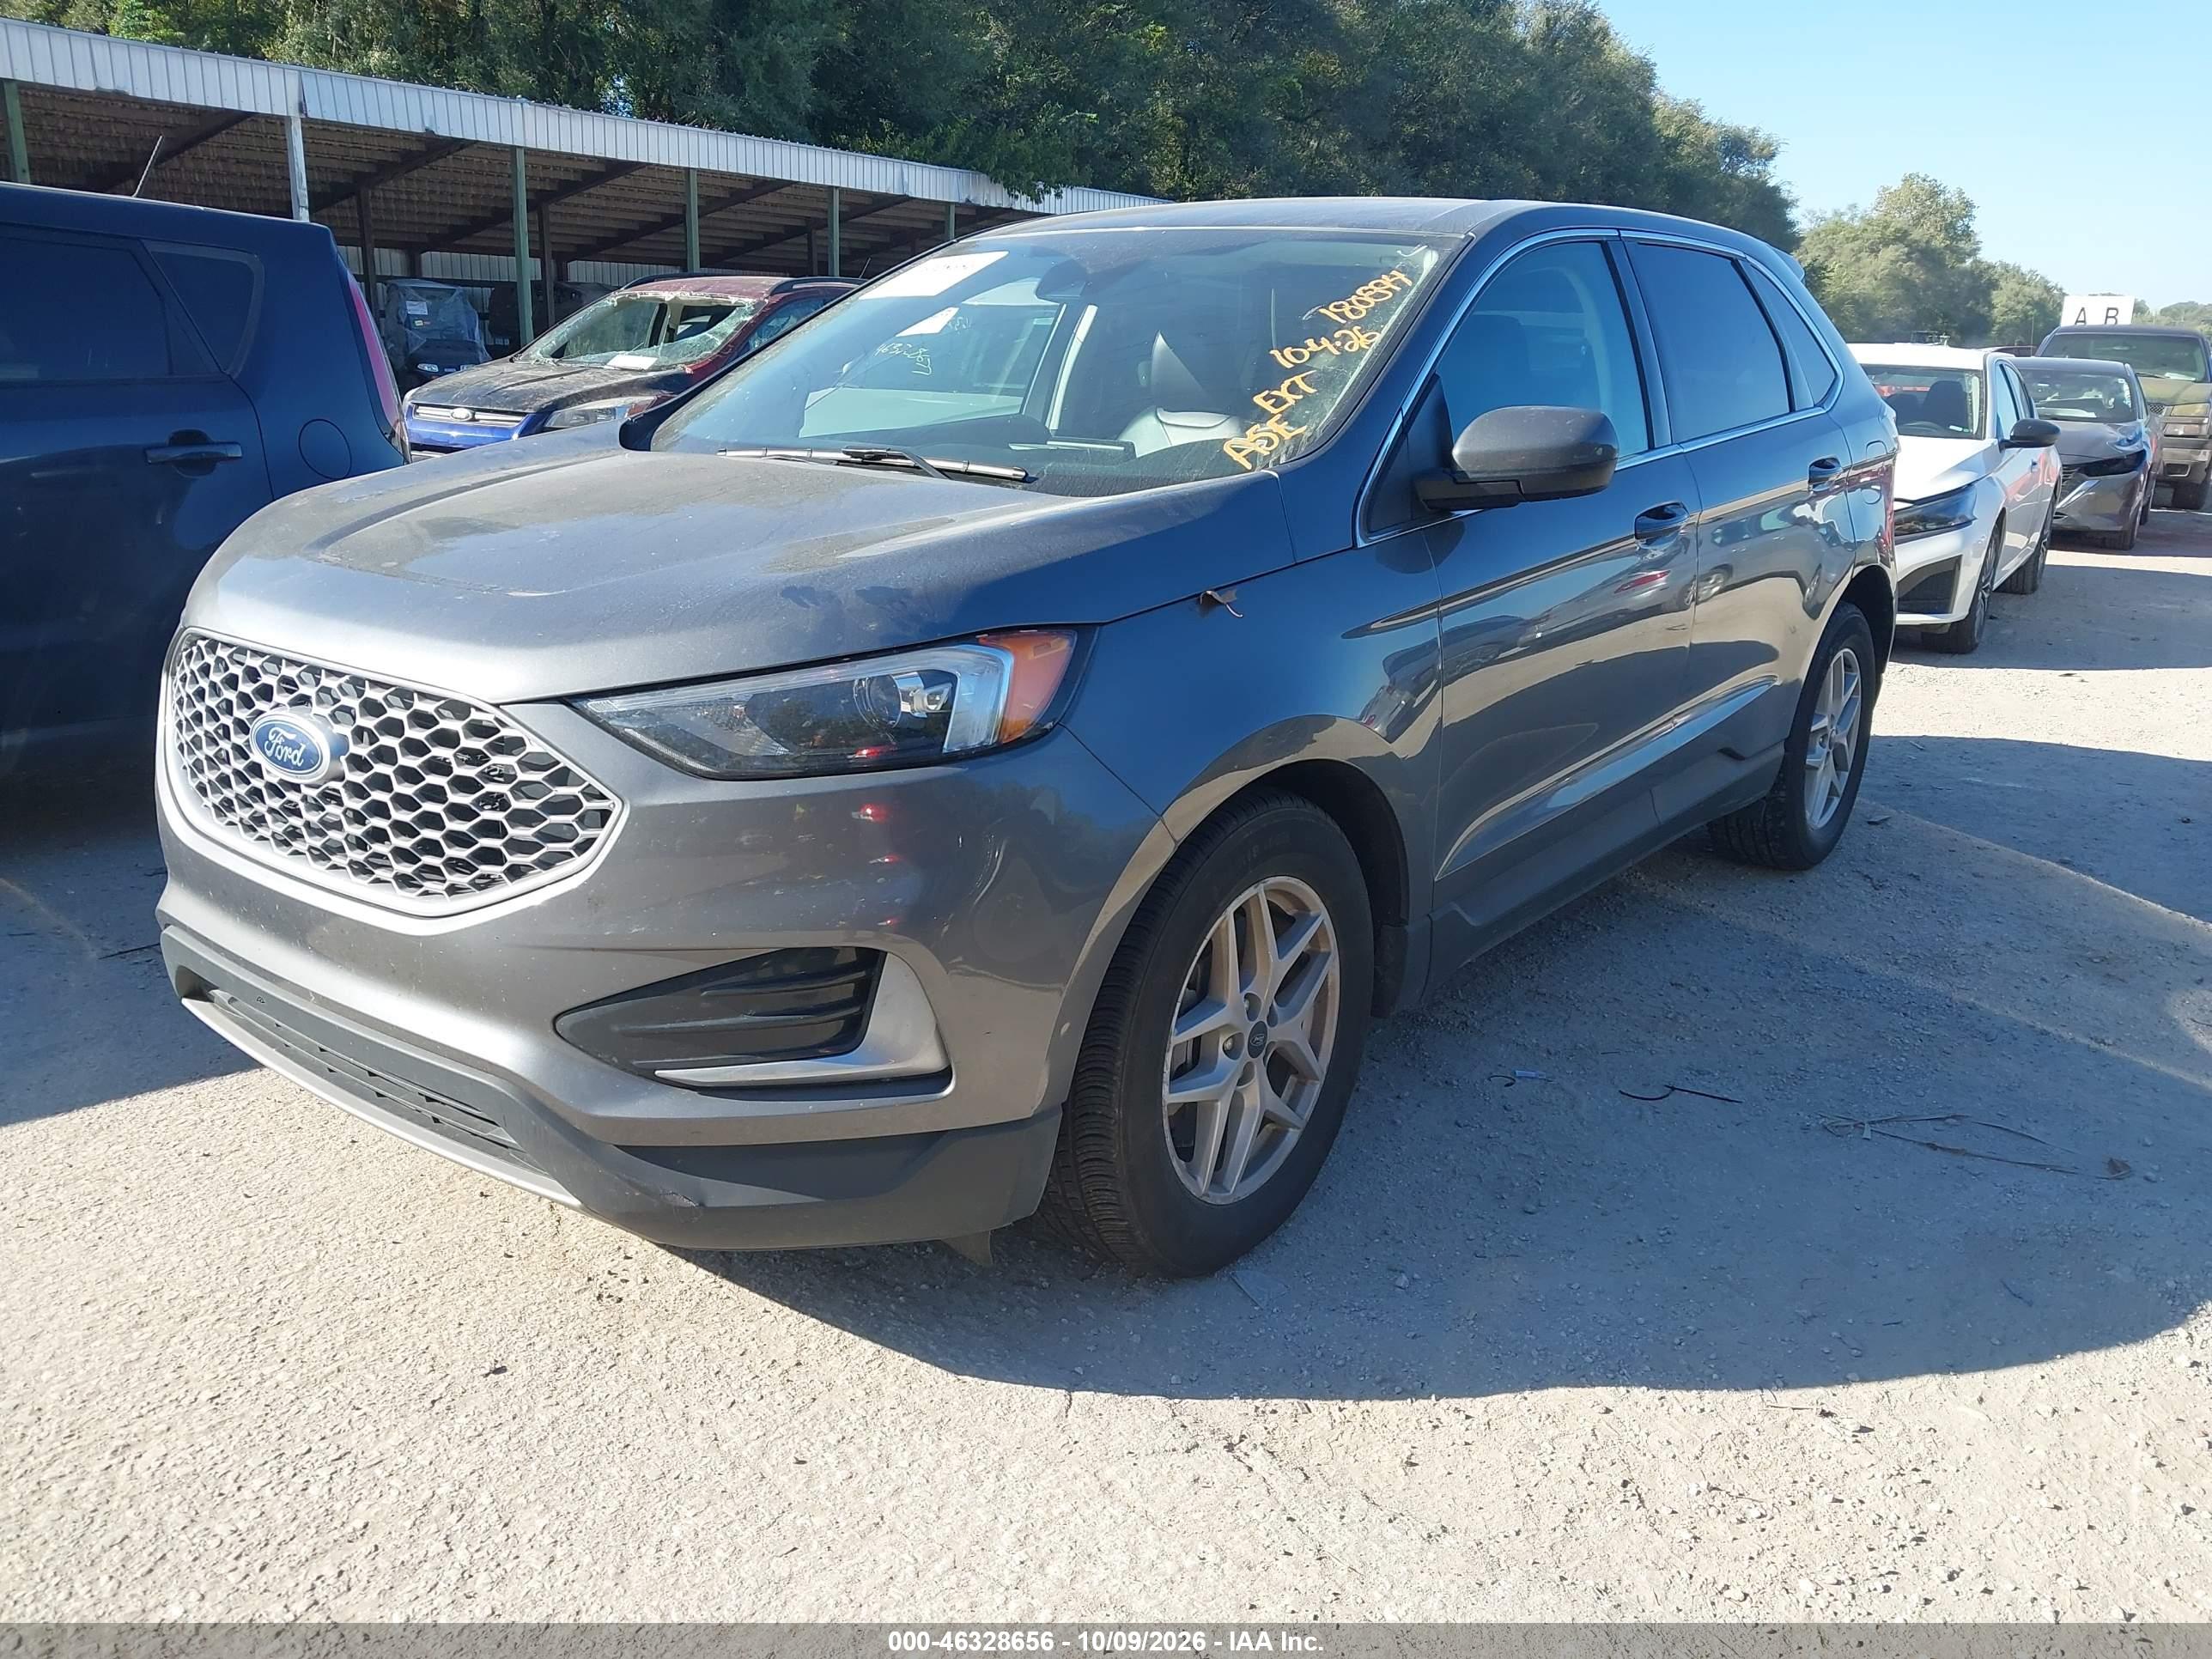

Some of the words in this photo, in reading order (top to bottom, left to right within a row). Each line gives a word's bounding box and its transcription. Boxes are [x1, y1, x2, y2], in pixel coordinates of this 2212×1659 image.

[2074, 307, 2087, 325] A
[2104, 307, 2120, 325] B
[1253, 369, 1318, 414] EXT
[264, 727, 307, 767] Ford
